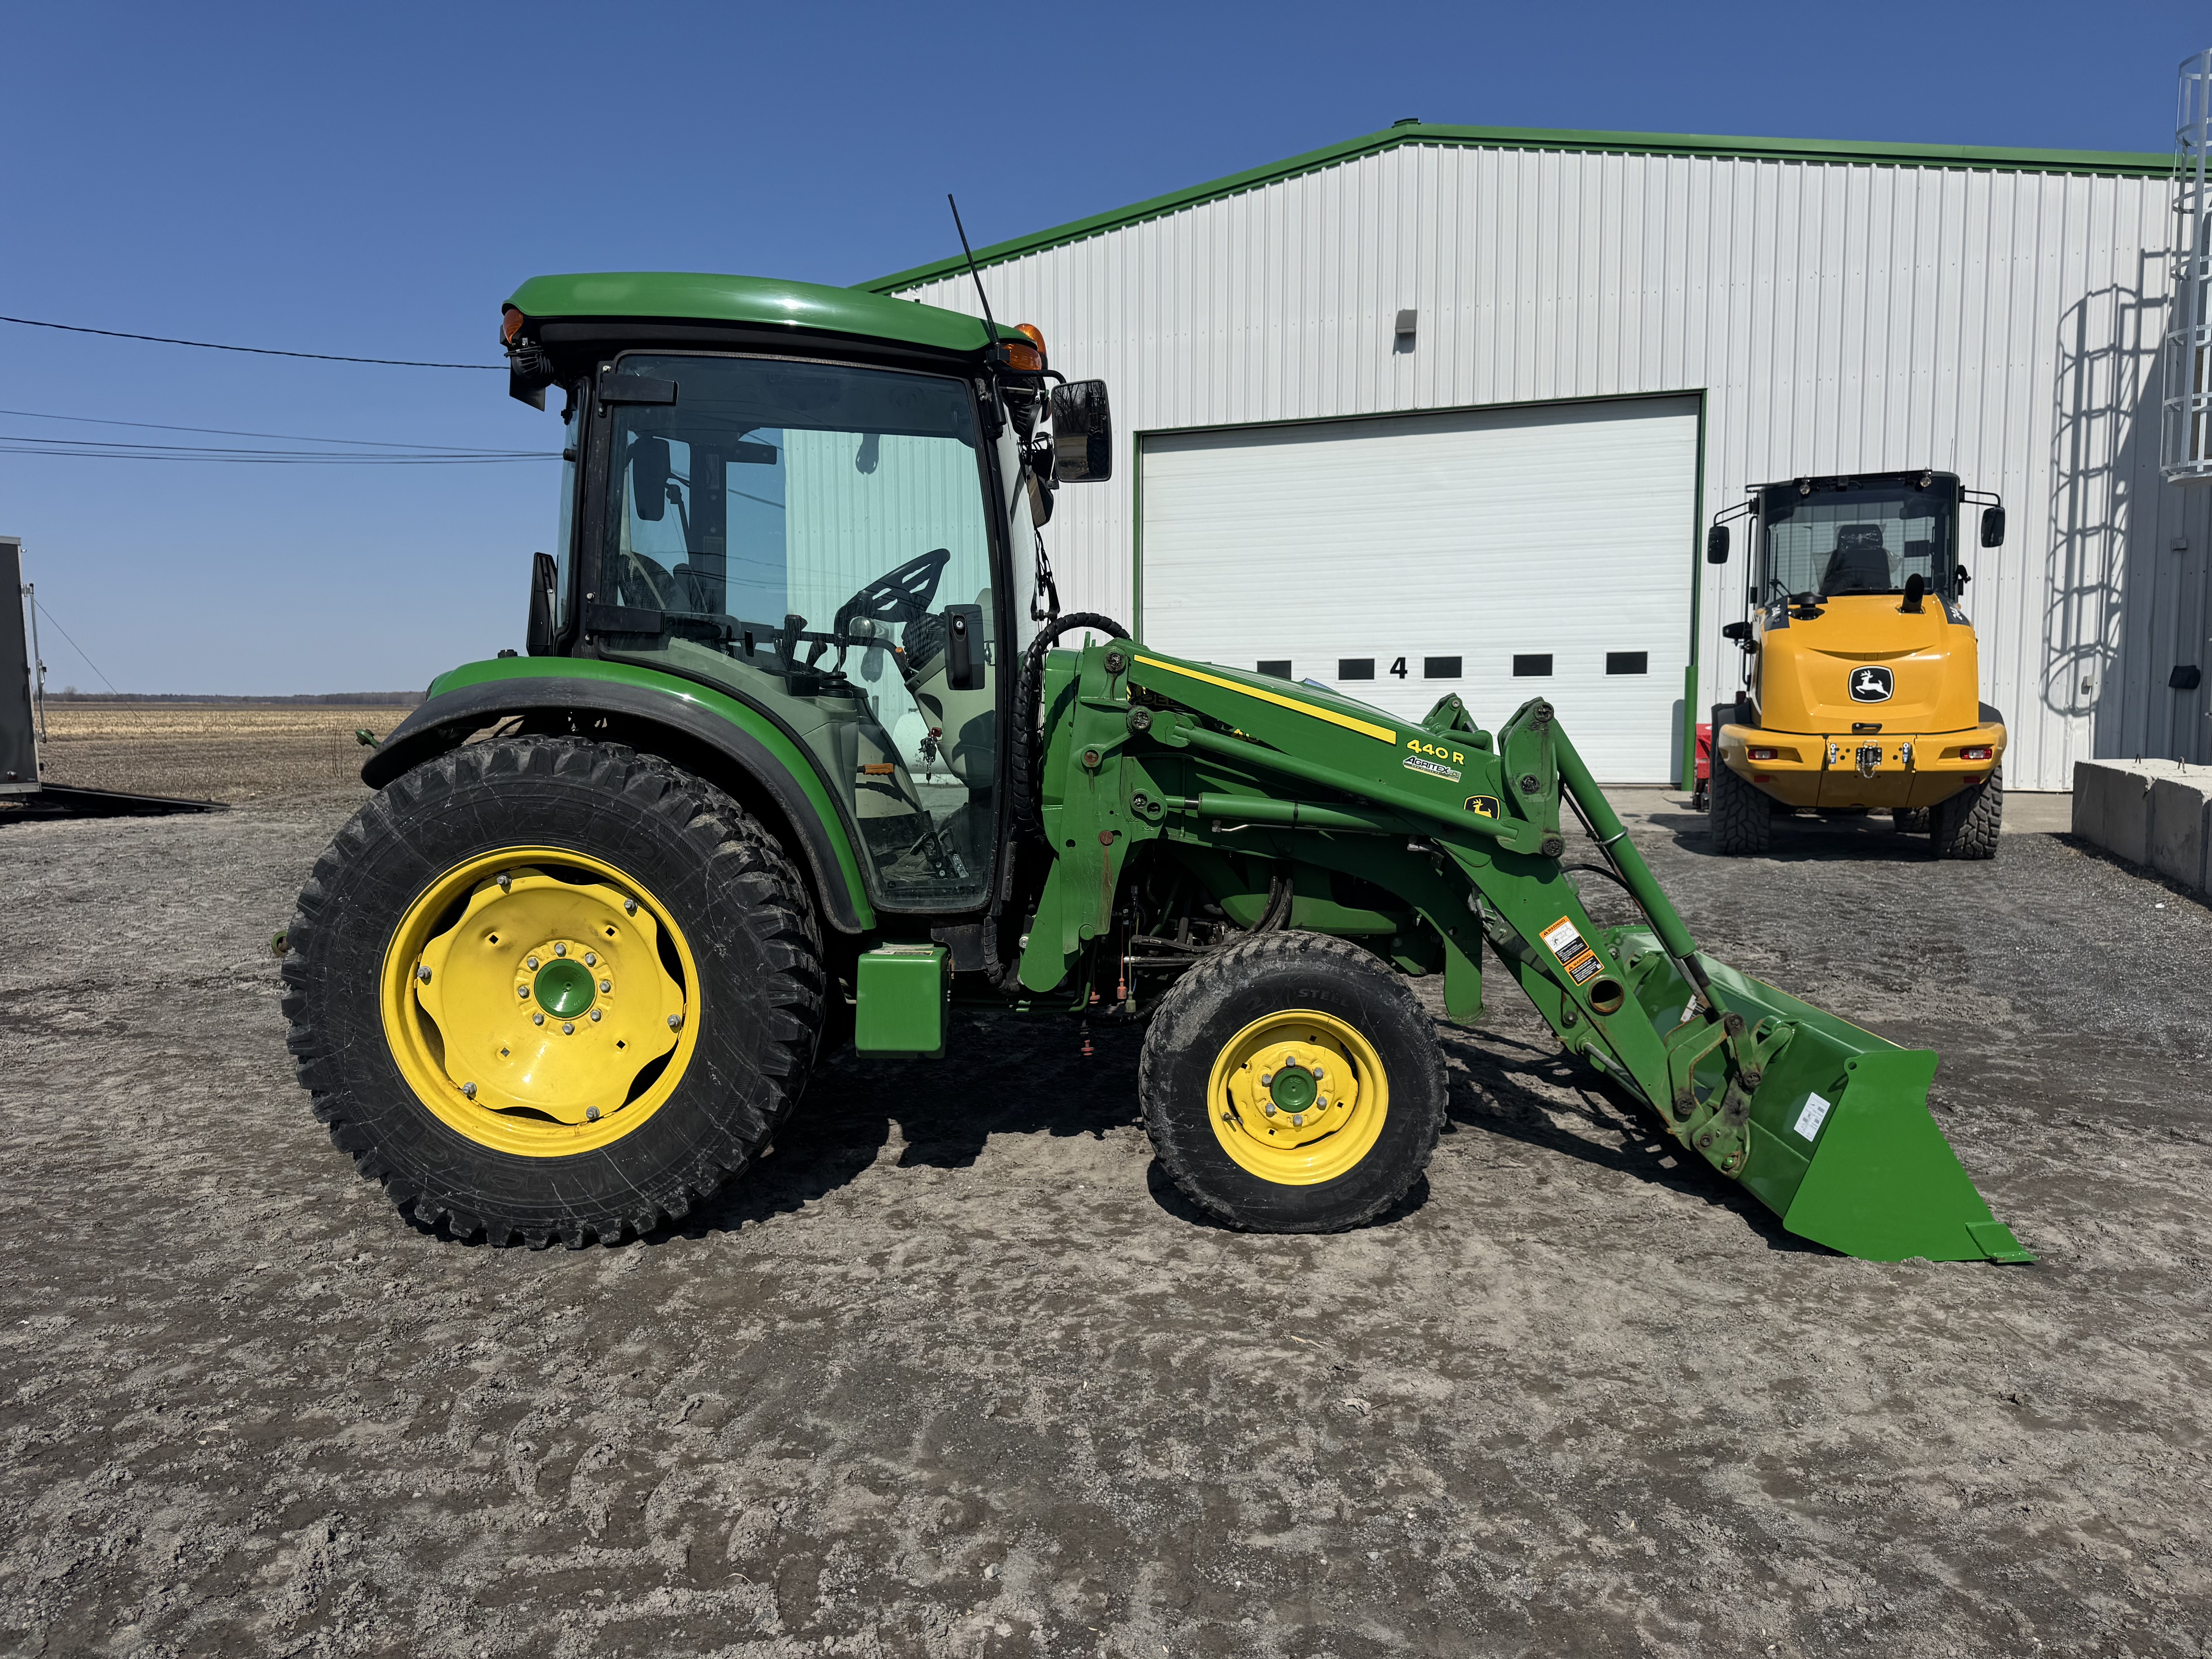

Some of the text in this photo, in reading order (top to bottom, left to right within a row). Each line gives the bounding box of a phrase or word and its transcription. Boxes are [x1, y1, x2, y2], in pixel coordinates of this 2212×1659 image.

[1390, 657, 1408, 679] 4
[1407, 739, 1464, 765] 440 R
[1405, 757, 1449, 773] AGRITEX
[1298, 988, 1349, 1007] STEEL
